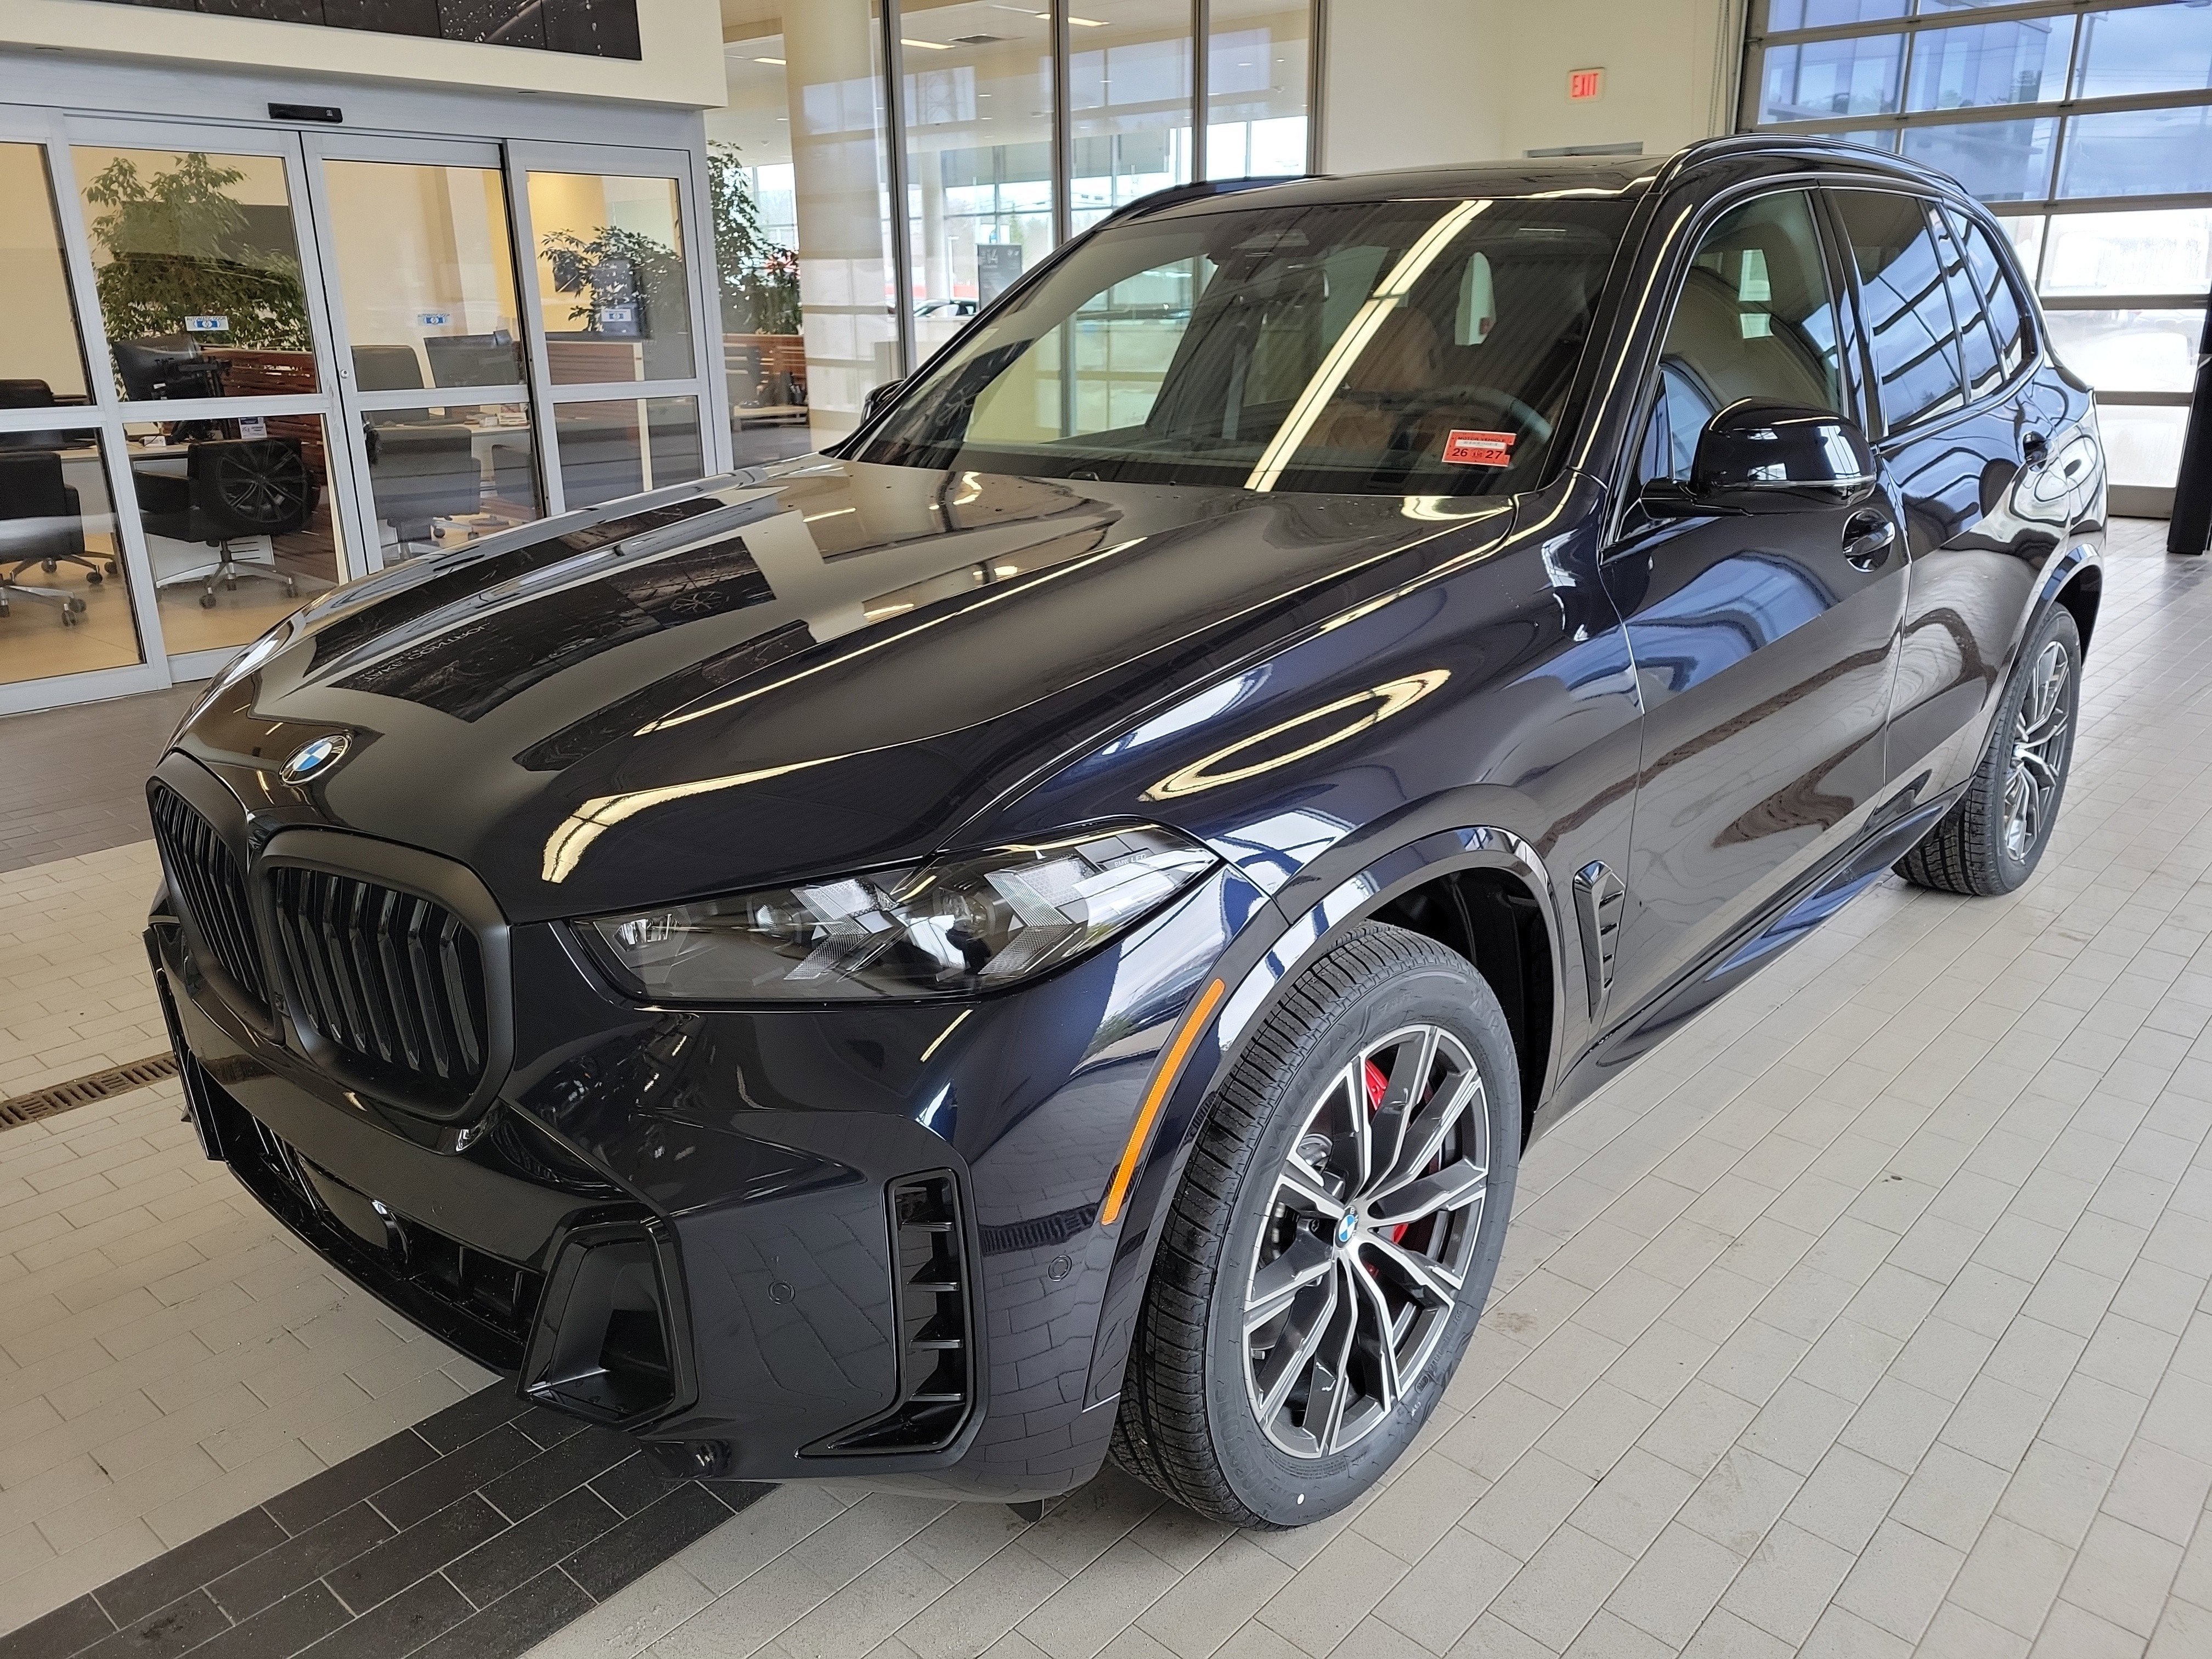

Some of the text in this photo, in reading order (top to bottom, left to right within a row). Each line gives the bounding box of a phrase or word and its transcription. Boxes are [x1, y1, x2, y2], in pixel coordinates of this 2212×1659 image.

[1572, 72, 1599, 97] EXIT
[1452, 448, 1469, 457] 26
[1485, 450, 1504, 459] 27
[1114, 854, 1147, 867] BMW LED
